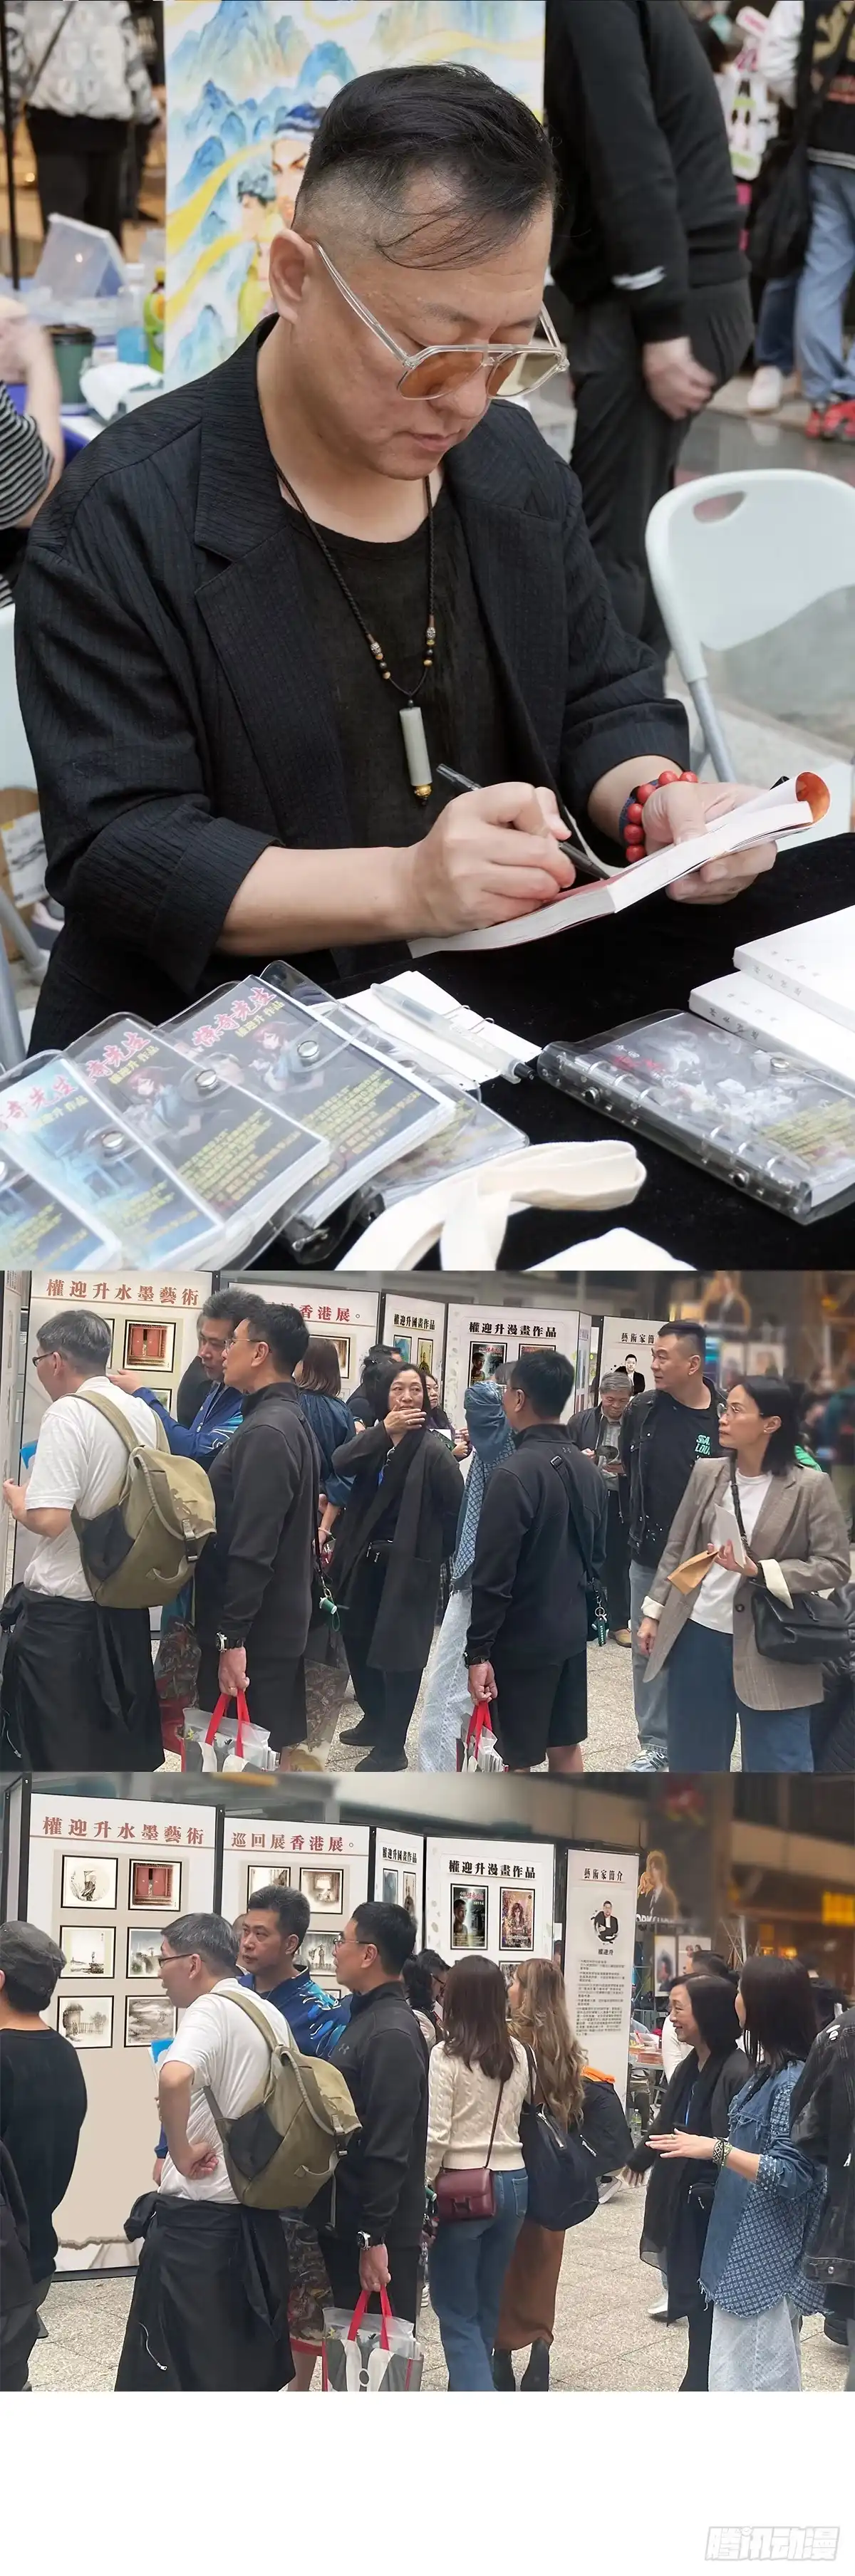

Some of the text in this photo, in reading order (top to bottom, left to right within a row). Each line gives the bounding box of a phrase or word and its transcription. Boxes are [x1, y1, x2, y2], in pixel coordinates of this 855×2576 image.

[46, 1278, 200, 1306] 權迎升水墨藝術
[469, 1321, 556, 1338] 權迎升漫畫作品
[43, 1816, 204, 1845] 權迎升水墨藝術
[449, 1860, 535, 1879] 權迎升漫畫作品
